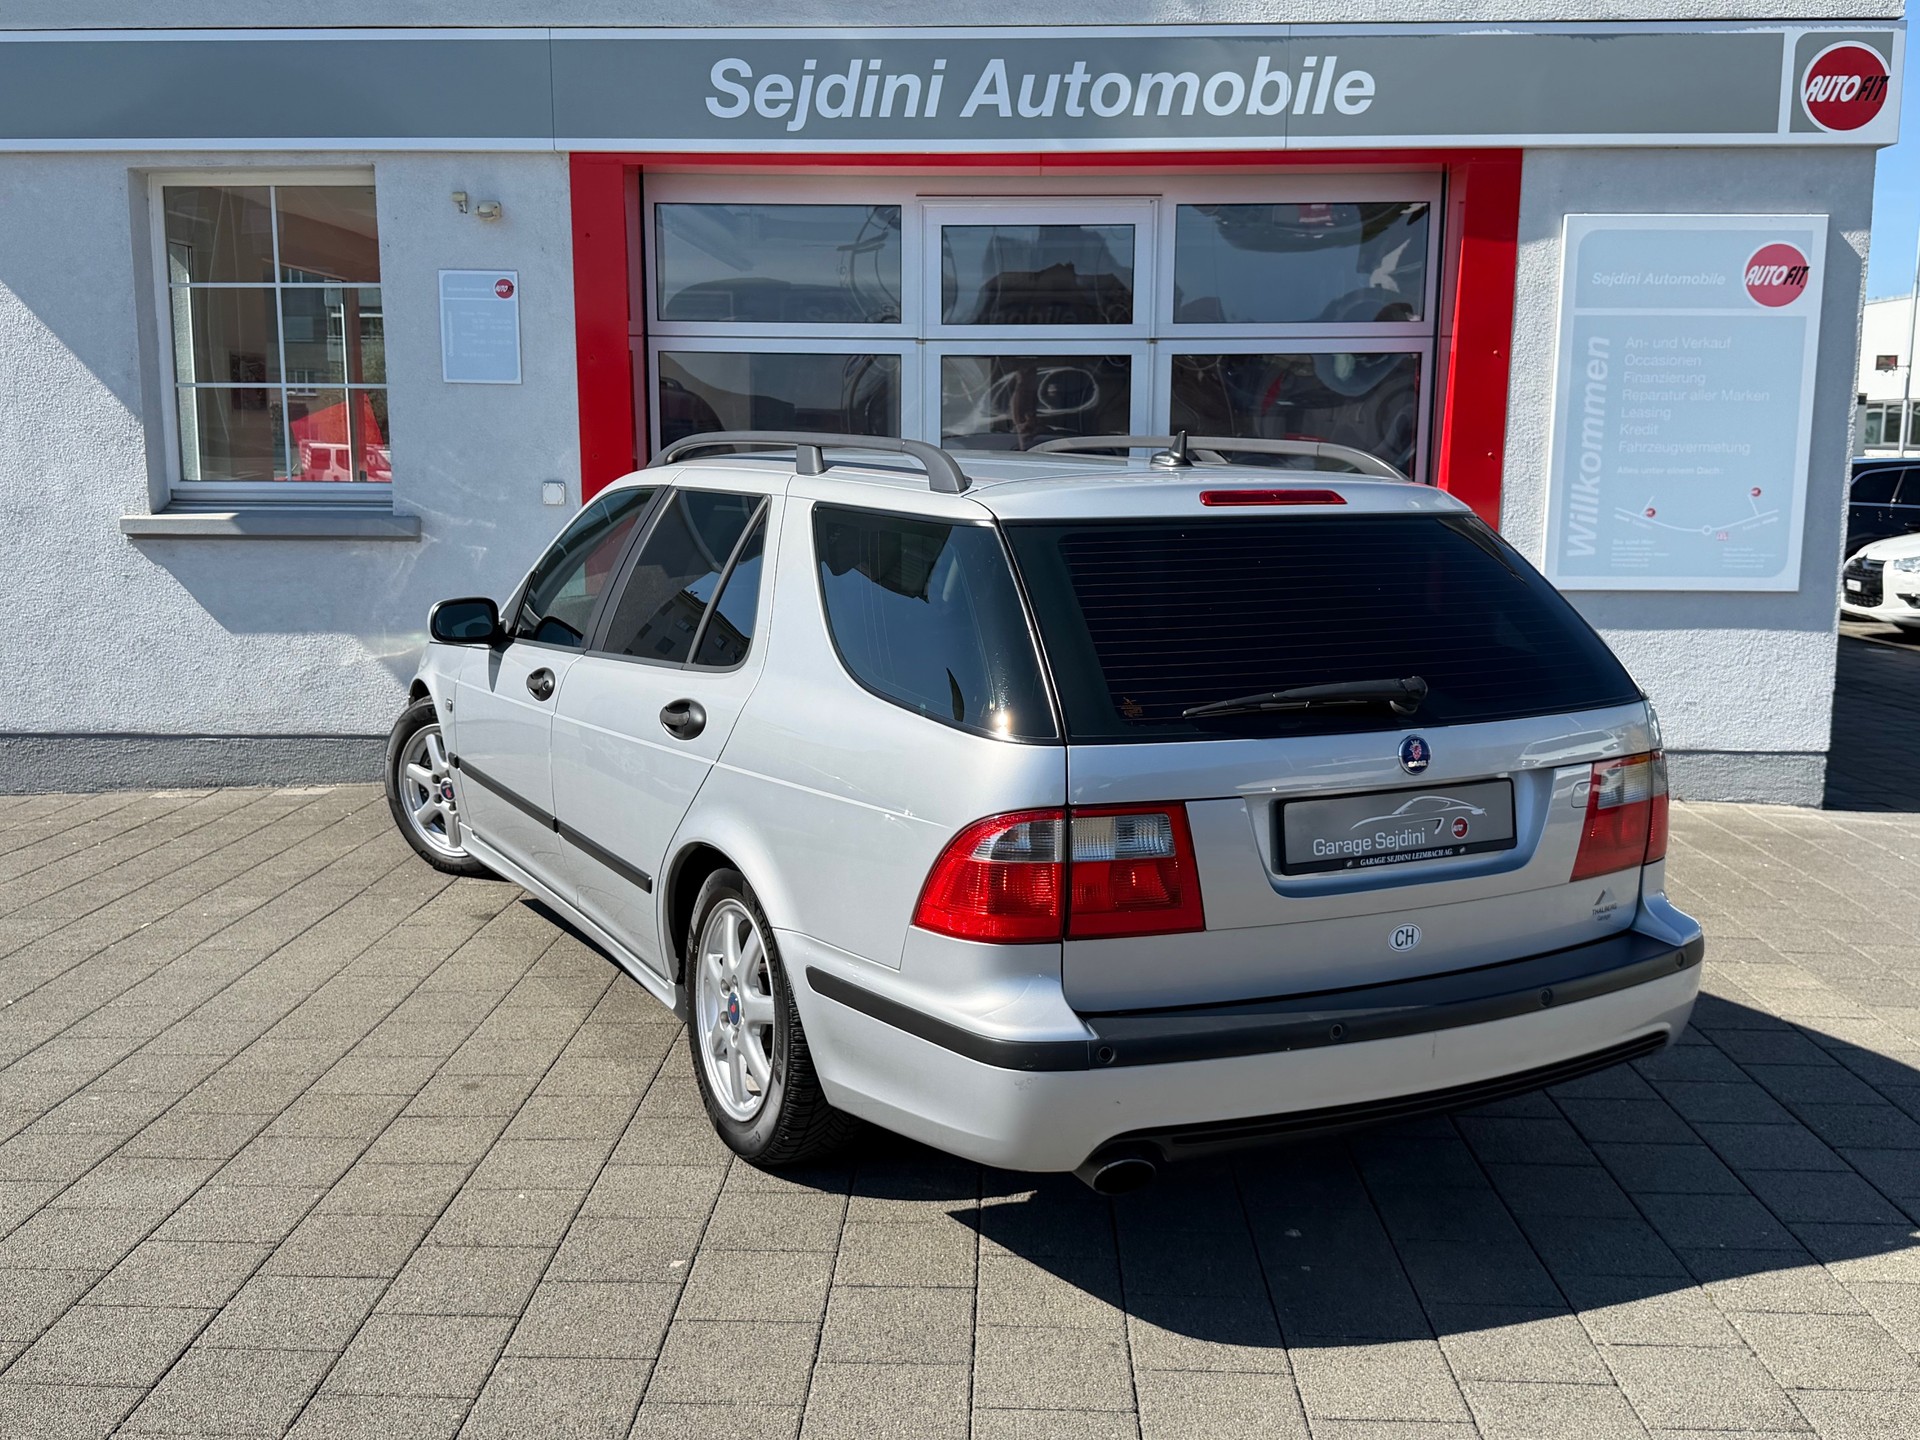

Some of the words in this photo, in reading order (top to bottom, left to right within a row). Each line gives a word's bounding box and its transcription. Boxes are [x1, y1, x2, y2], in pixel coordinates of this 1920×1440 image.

[705, 58, 947, 132] Sejdini
[960, 55, 1376, 118] Automobile
[1806, 75, 1890, 102] AUTOFIT
[1592, 271, 1641, 286] Sejdini
[1644, 272, 1726, 286] Automobile
[1745, 265, 1810, 286] AUTOFIT
[1625, 336, 1649, 349] An-
[1652, 336, 1678, 349] und
[1681, 335, 1732, 349] Verkauf
[1624, 353, 1702, 367] Occasionen
[1623, 371, 1706, 386] Finanzierung
[1622, 388, 1687, 404] Reparatur
[1689, 389, 1718, 401] aller
[1720, 389, 1770, 402] Marken
[1620, 406, 1672, 421] Leasing
[1619, 423, 1659, 436] Kredit
[1565, 335, 1611, 557] Willkommen
[1618, 440, 1750, 456] Fahrzeugvermietung
[1313, 838, 1372, 856] Garage
[1375, 827, 1425, 850] Sejdini
[1360, 856, 1386, 866] GARAGE
[1386, 853, 1412, 863] SEJDINI
[1395, 928, 1415, 946] CH
